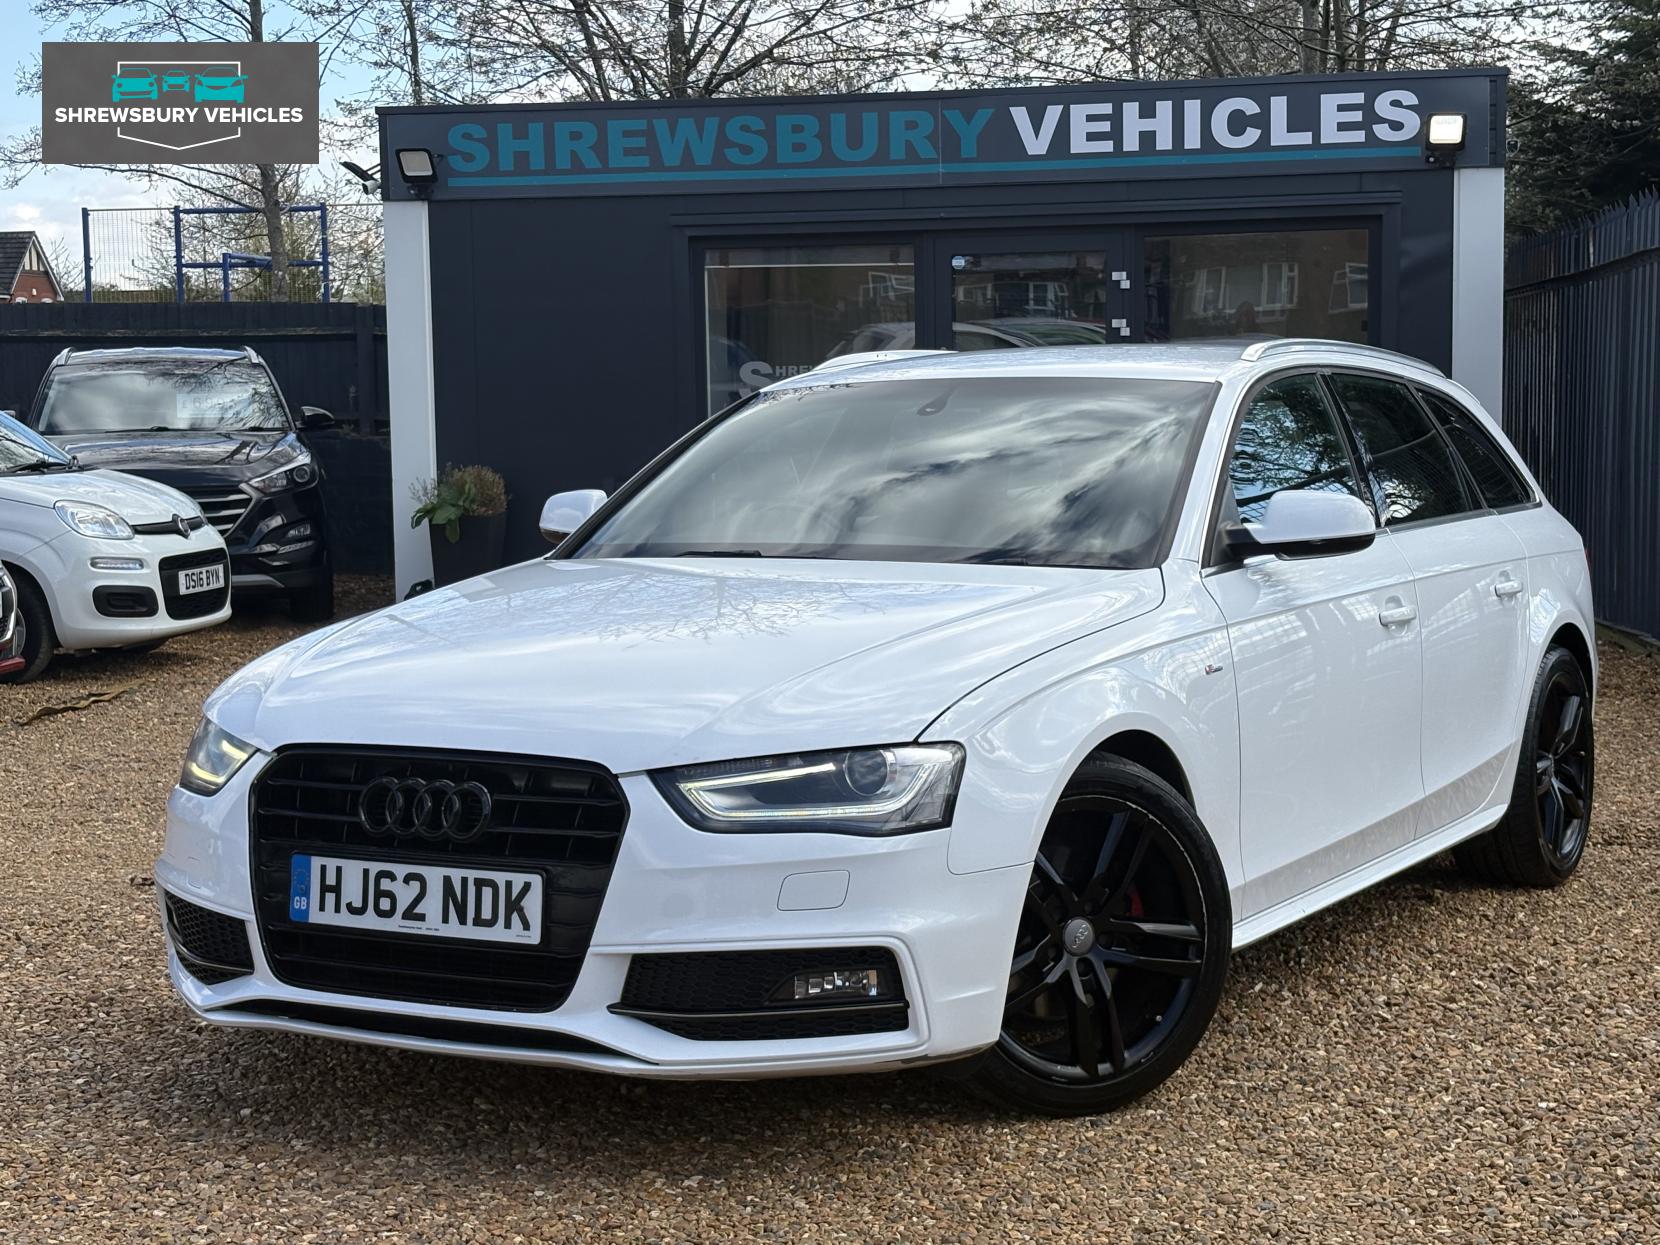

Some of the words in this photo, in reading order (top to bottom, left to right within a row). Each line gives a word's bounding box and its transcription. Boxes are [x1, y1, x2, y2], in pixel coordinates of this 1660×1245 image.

[447, 108, 994, 173] SHREWSBURY
[1009, 90, 1421, 156] VEHICLES
[185, 571, 204, 590] DS16
[206, 567, 220, 586] BYN
[293, 896, 307, 910] GB
[318, 864, 428, 922] HJ62
[441, 875, 532, 932] NDK
